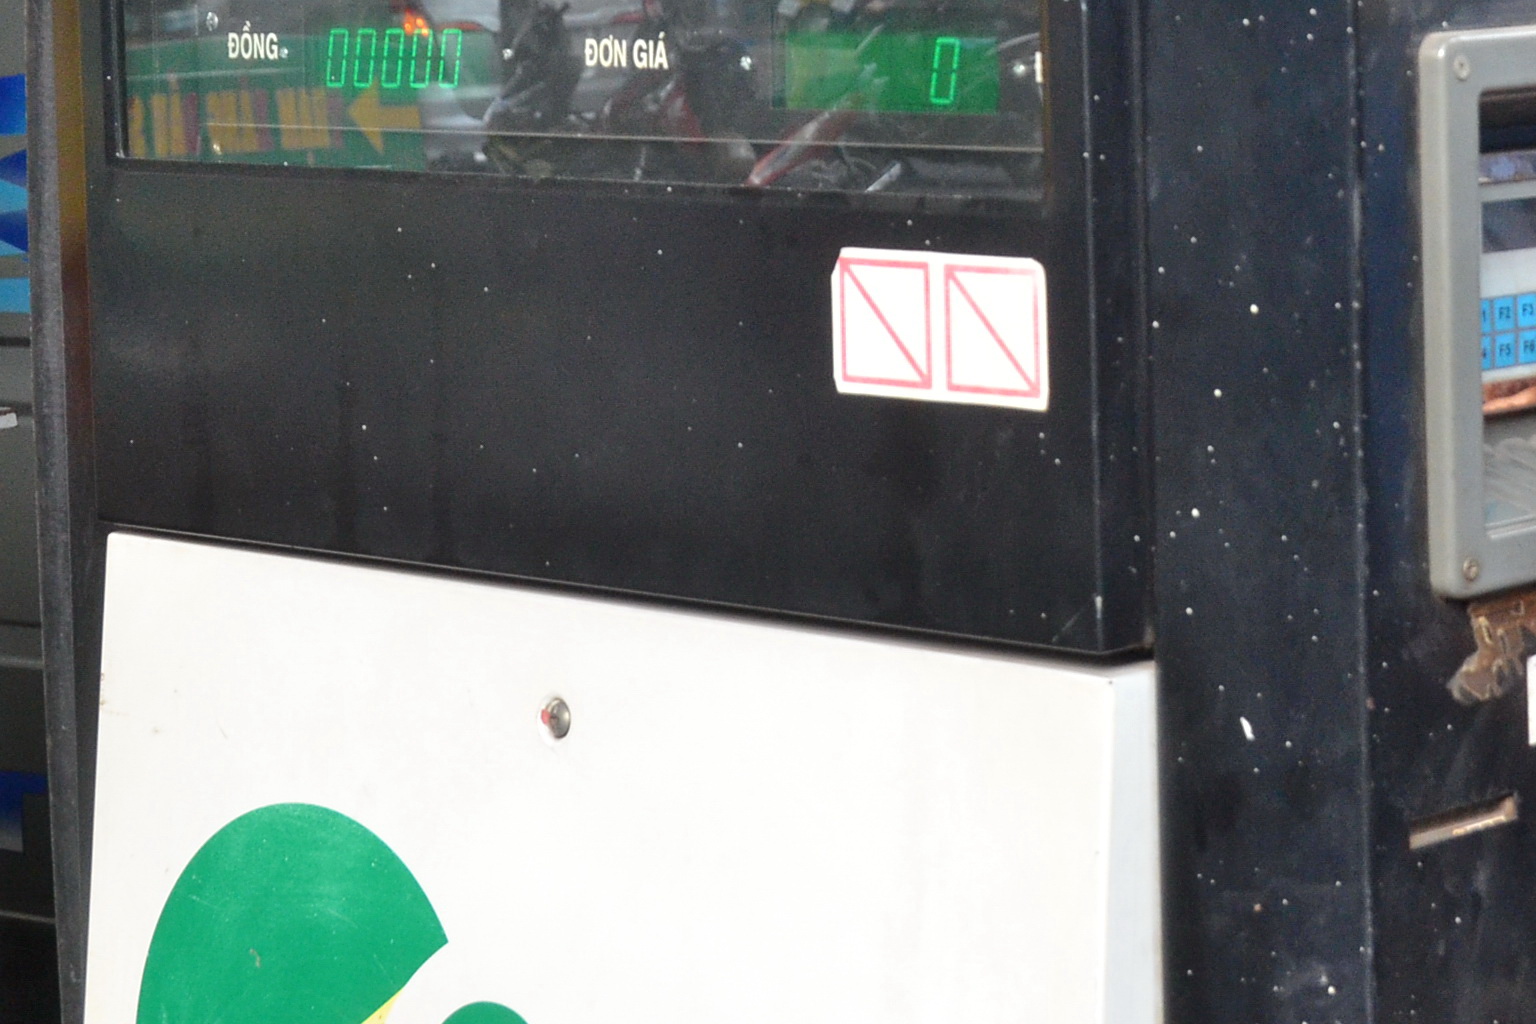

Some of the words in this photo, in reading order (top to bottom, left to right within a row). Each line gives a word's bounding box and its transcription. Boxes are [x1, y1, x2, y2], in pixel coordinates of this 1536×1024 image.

[228, 21, 279, 60] ĐỒNG
[584, 35, 627, 69] ĐƠN
[632, 31, 669, 70] GIÁ
[327, 28, 462, 88] 00000
[930, 37, 960, 105] 0
[1499, 306, 1511, 320] F2
[1522, 303, 1534, 316] F3
[1499, 343, 1511, 357] F5
[1523, 340, 1536, 353] F6
